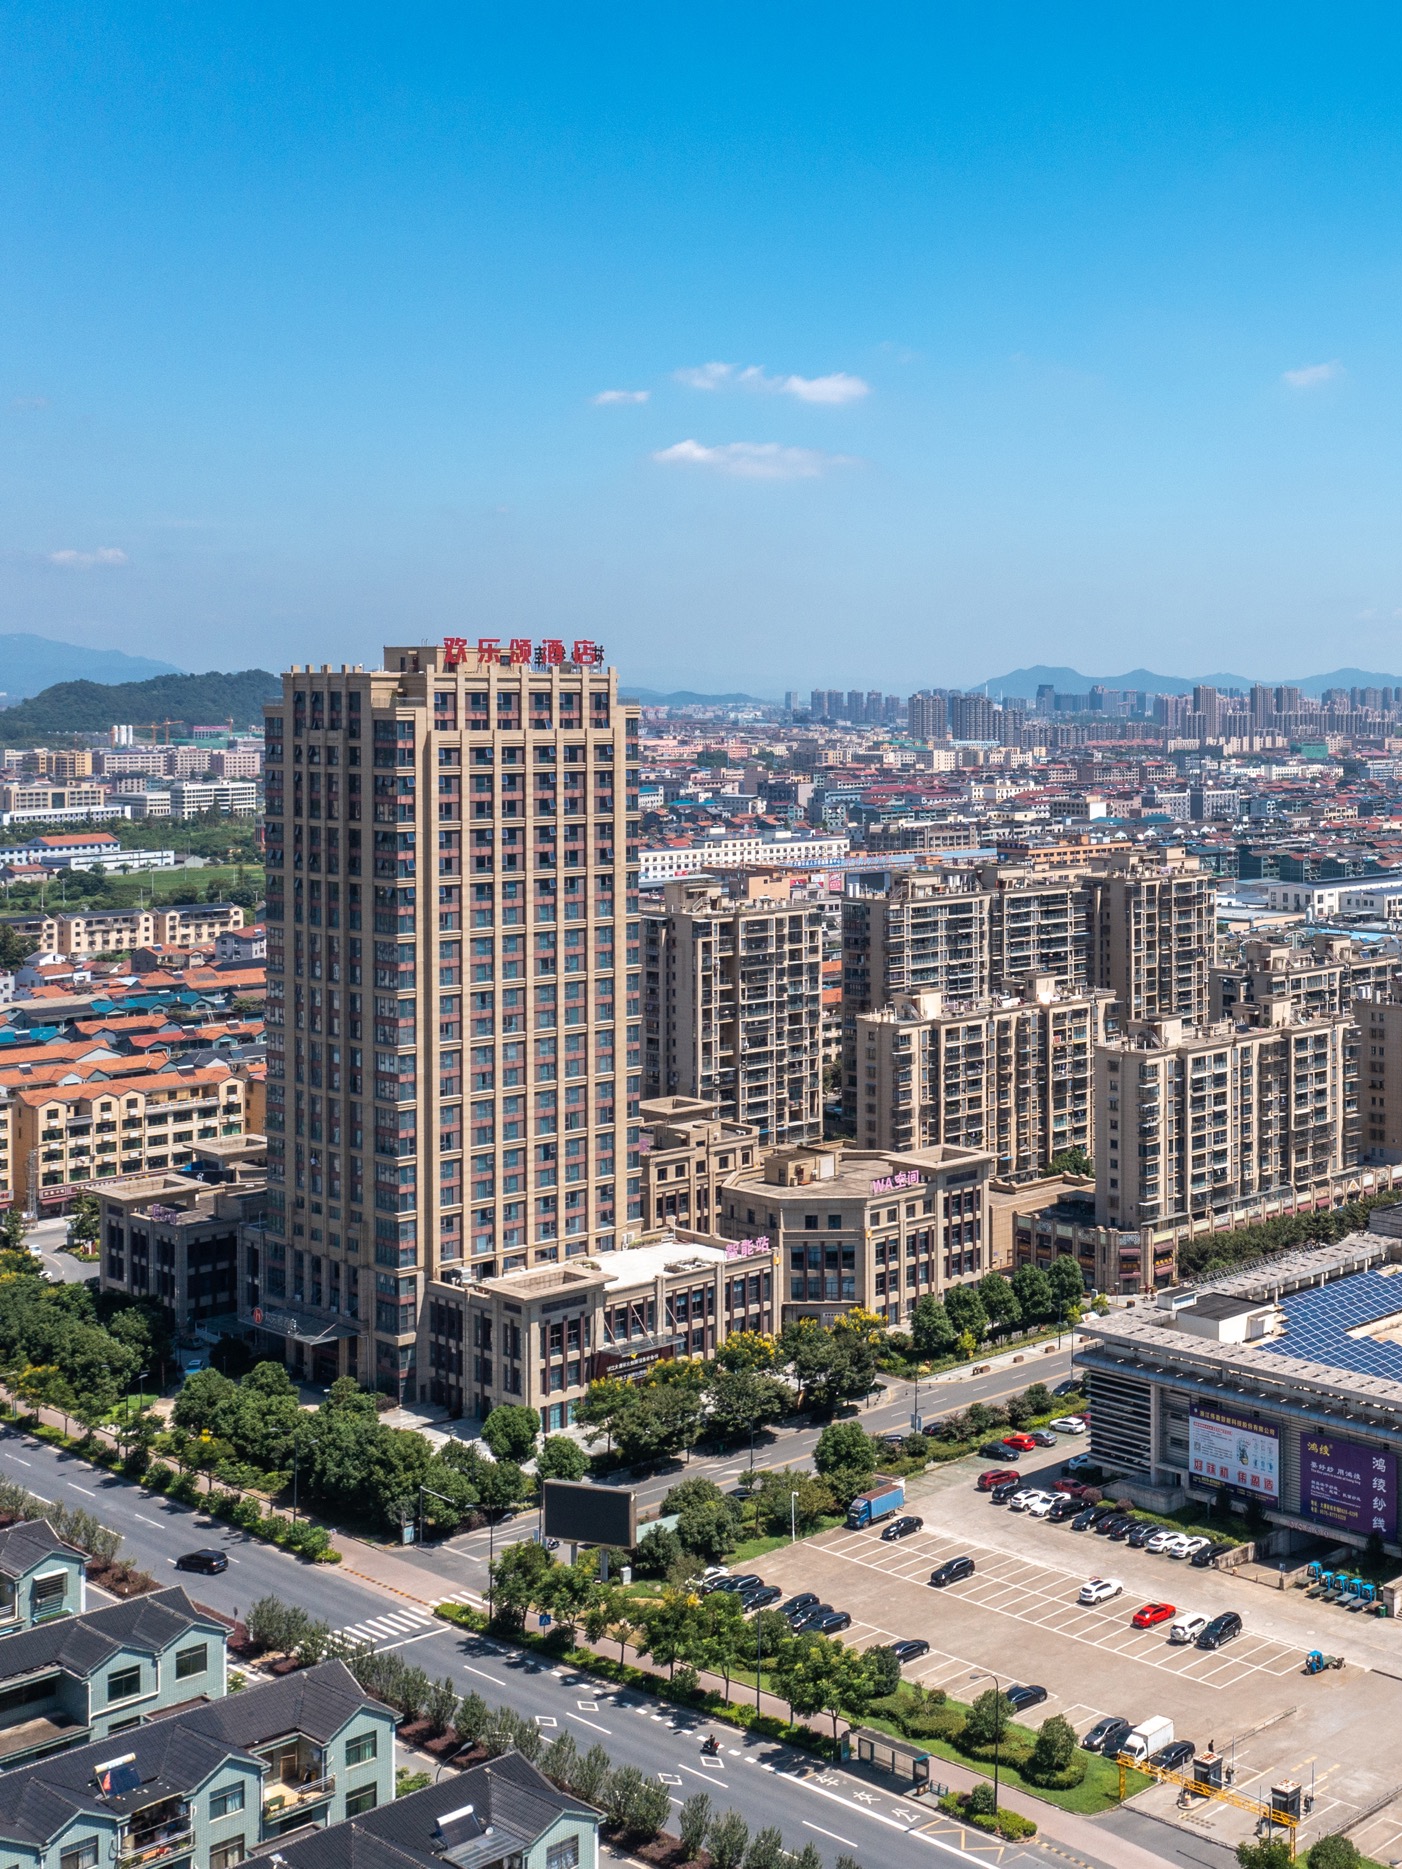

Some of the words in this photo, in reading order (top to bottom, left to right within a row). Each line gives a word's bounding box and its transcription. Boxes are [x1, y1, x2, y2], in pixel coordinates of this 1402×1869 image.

[443, 637, 596, 665] 欢乐颂酒店
[872, 1169, 919, 1194] WA空间
[725, 1235, 770, 1259] 智能站
[1371, 1455, 1387, 1533] 鸿绫纱线
[815, 1774, 921, 1823] 公交车
